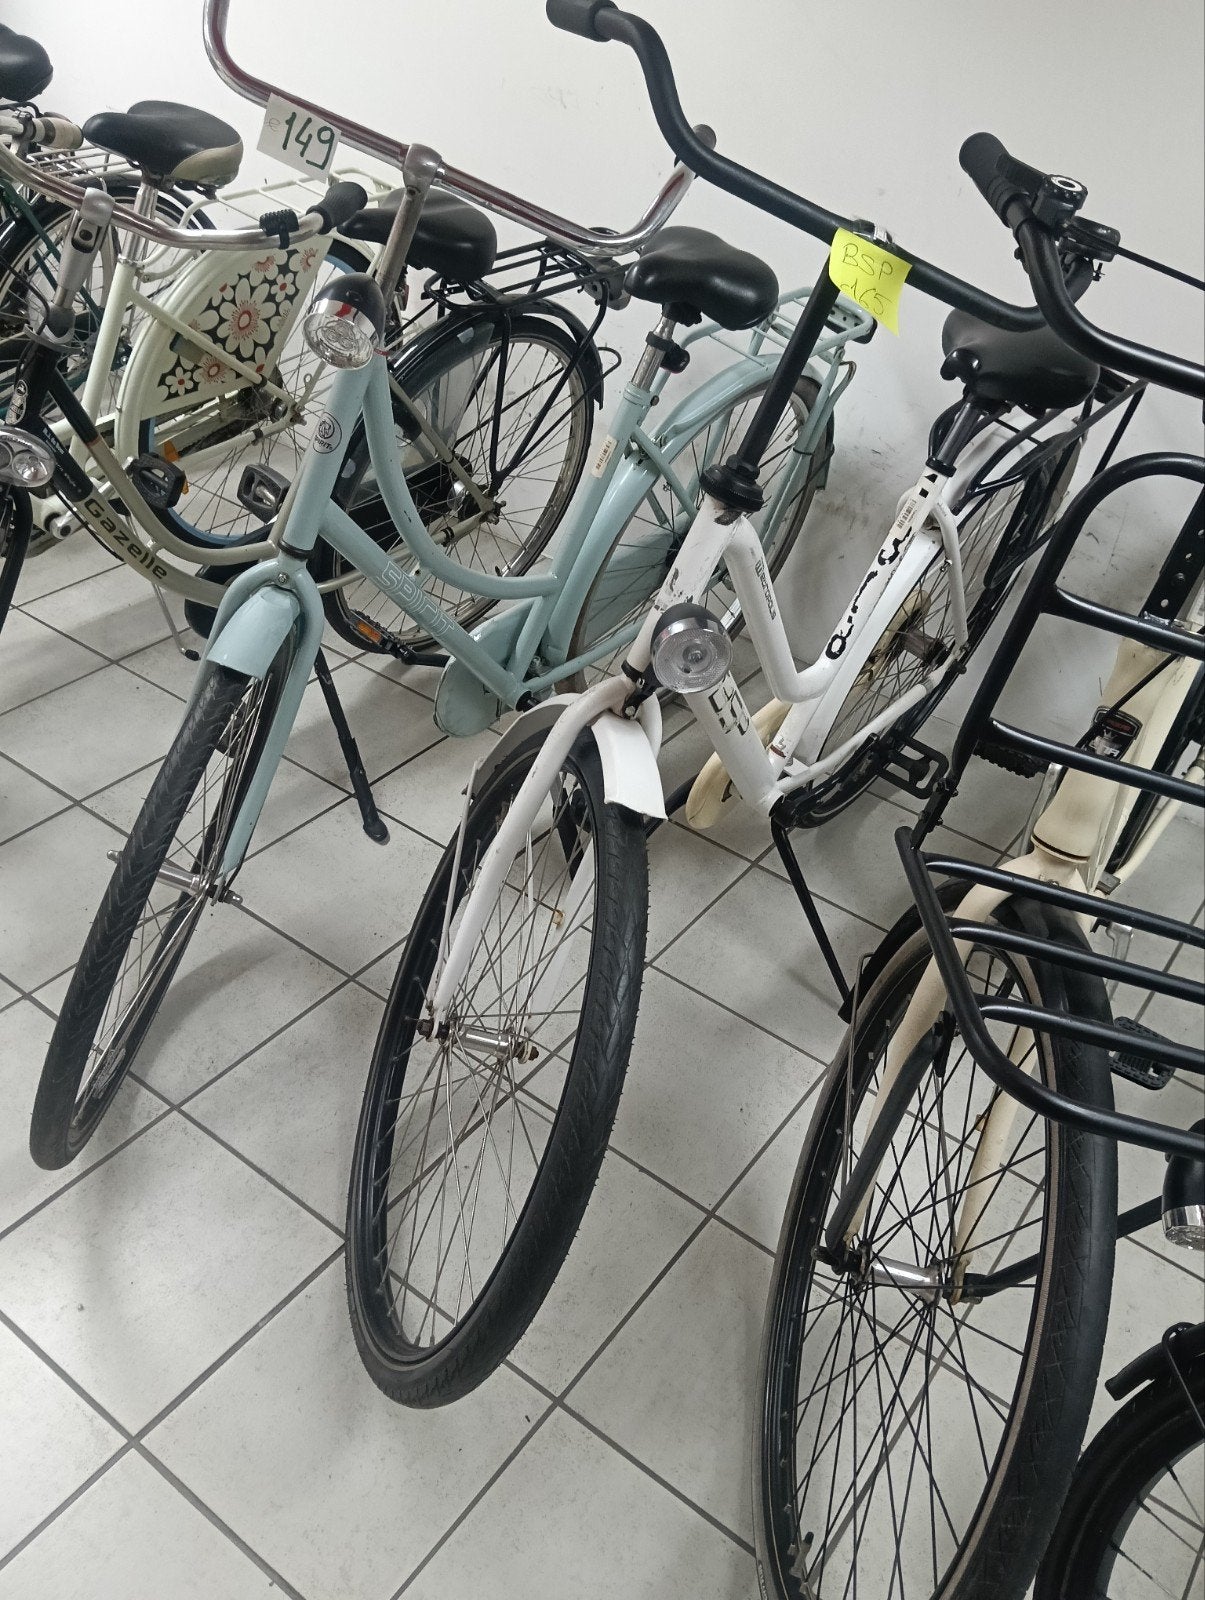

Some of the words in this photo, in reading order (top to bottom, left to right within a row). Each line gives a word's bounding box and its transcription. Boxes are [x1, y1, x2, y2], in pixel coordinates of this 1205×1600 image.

[282, 112, 335, 170] 149
[843, 243, 893, 280] BSP
[84, 498, 167, 580] Gazelle
